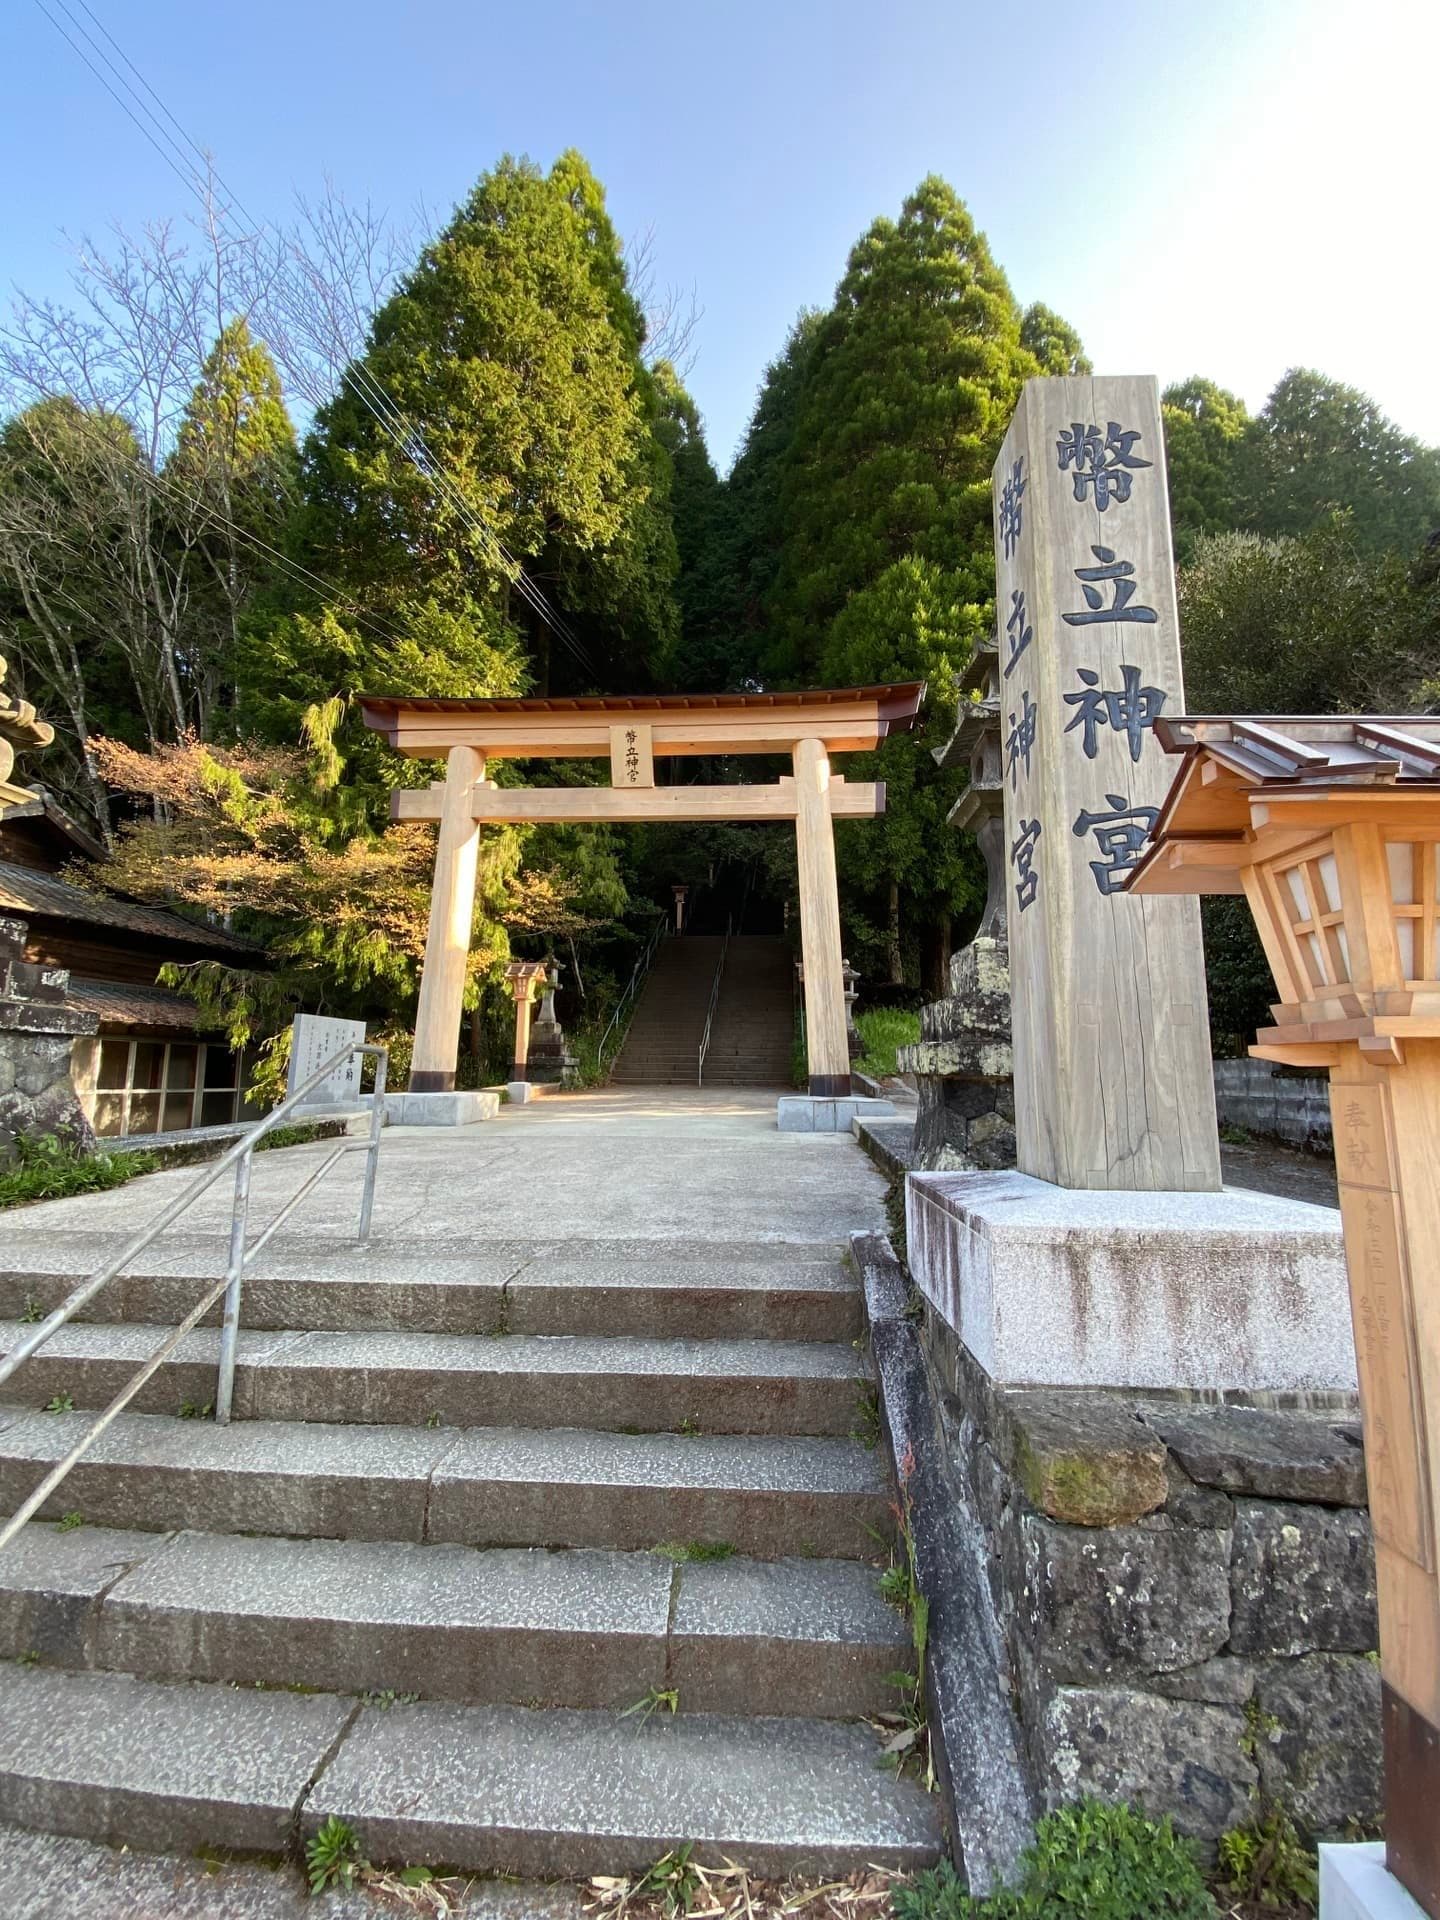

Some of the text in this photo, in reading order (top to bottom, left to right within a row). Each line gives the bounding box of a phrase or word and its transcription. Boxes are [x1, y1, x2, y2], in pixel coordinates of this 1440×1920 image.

[625, 729, 639, 783] 幣立神宮
[999, 456, 1042, 913] 幣立神宮
[1056, 421, 1169, 896] 幣立神宮
